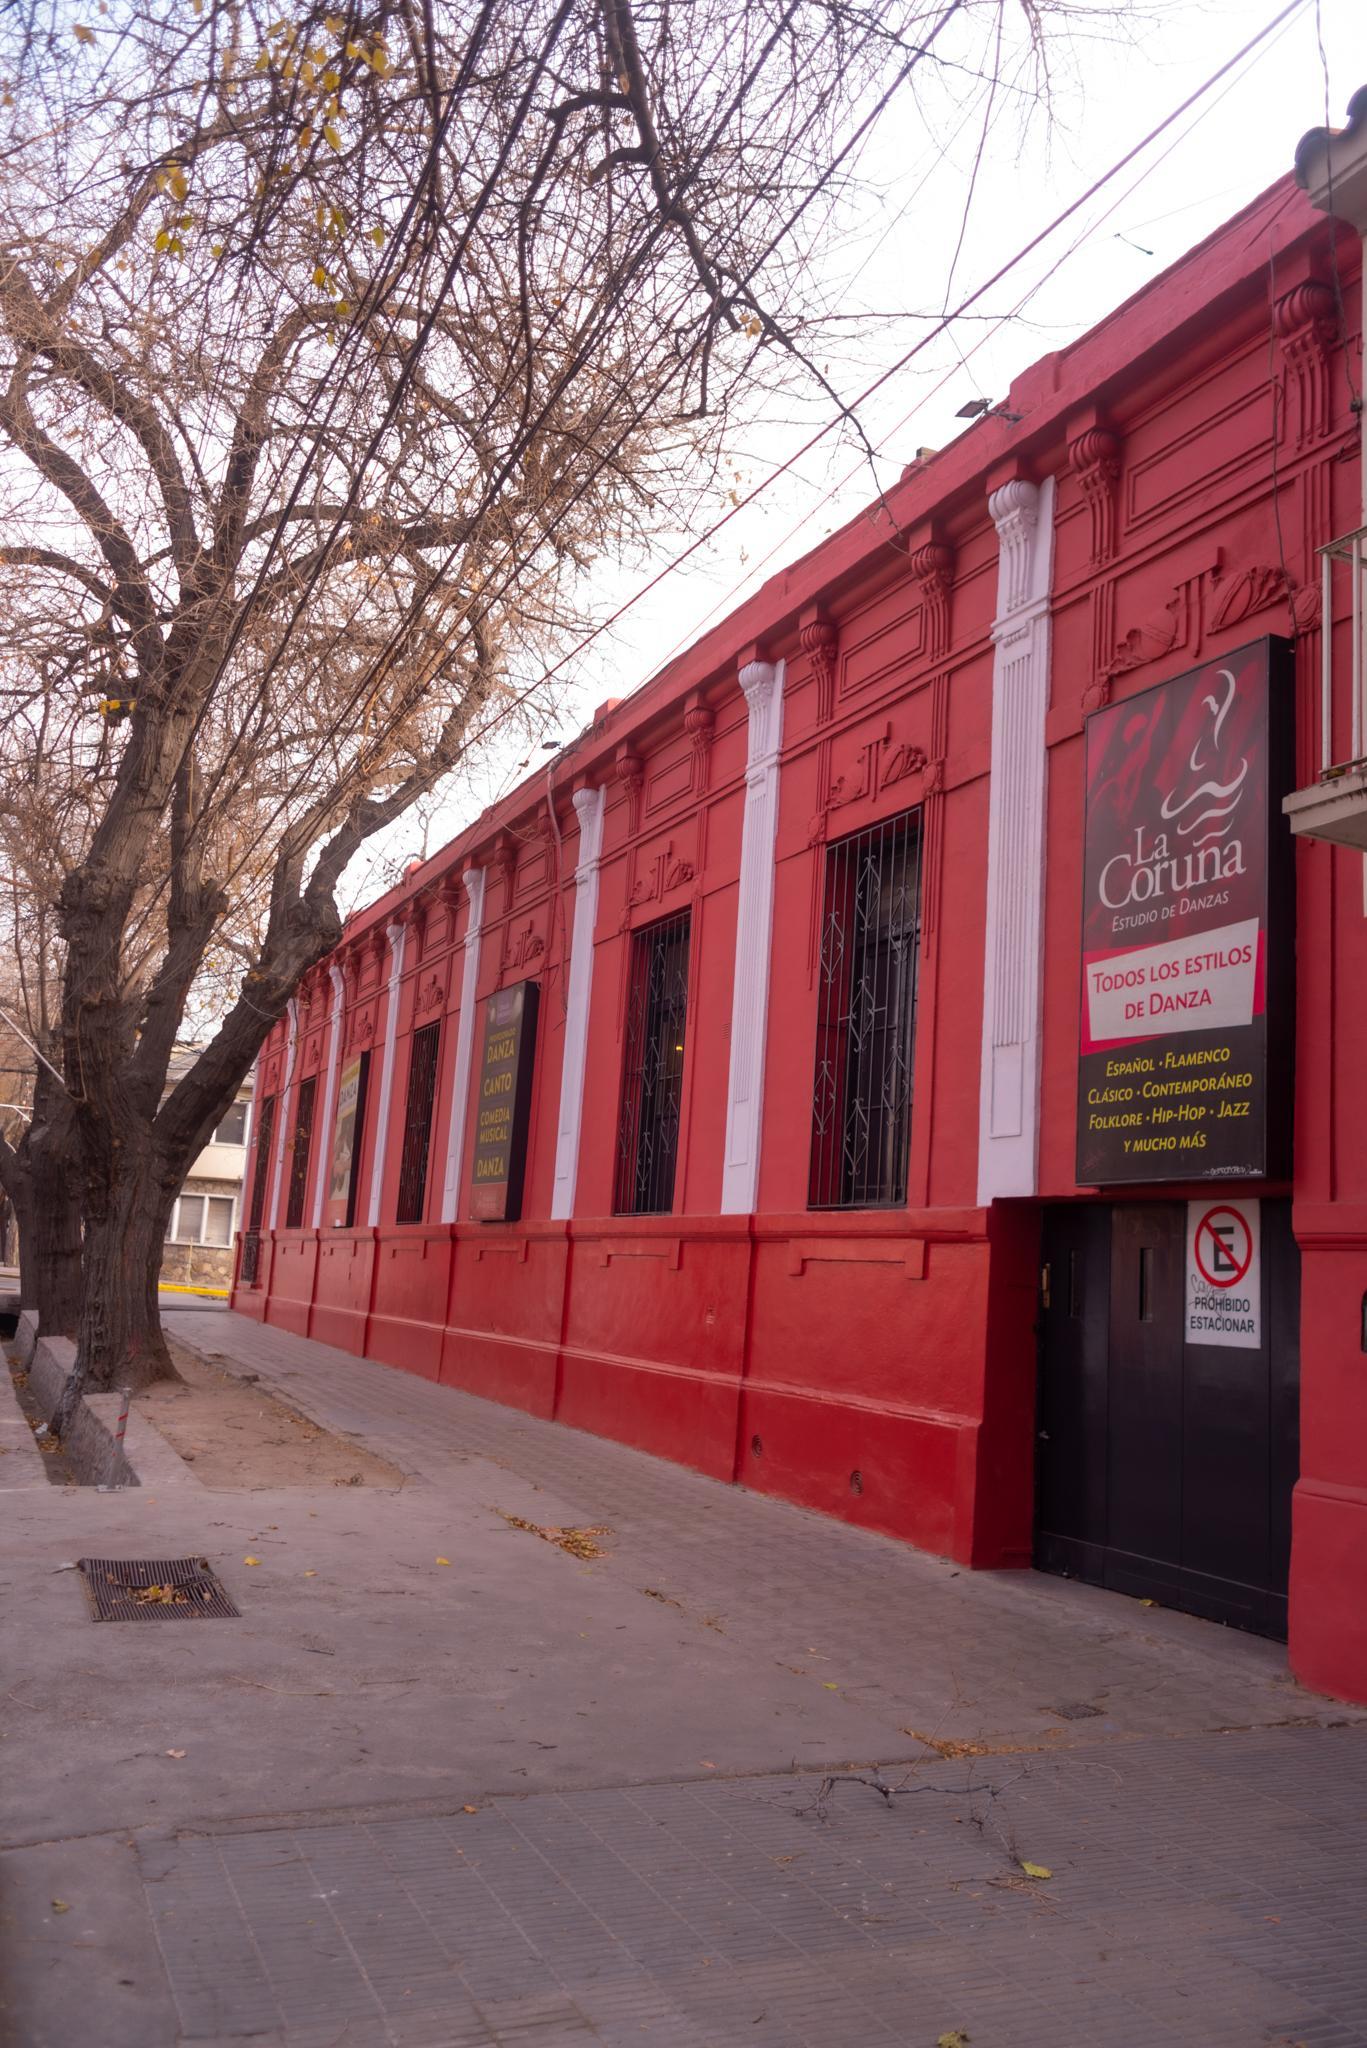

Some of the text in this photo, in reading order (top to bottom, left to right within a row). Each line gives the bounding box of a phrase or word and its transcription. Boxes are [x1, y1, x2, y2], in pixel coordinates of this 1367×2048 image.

[1134, 826, 1170, 866] La
[1099, 822, 1246, 908] Coruña
[1112, 891, 1230, 932] ESTUDIO DE DANZAS
[1092, 945, 1252, 993] TODOS LOS ESTILOS
[1125, 989, 1212, 1020] DE DANZA
[488, 1040, 515, 1064] DANZA
[1106, 1047, 1231, 1077] ESPAÑOL FLAMENCO
[484, 1072, 512, 1096] CANTO
[1088, 1072, 1253, 1104] CLÁSICO CONTEMPORÁNEO
[1089, 1101, 1250, 1130] FOLKLORE HIP-HOP JAZZ
[480, 1126, 508, 1144] MUSICAL
[1124, 1131, 1207, 1152] Y MUCHO MÁS
[477, 1157, 504, 1177] DANZA
[1194, 1296, 1250, 1313] PROHIBIDO
[1190, 1316, 1255, 1333] ESTACIONAR
